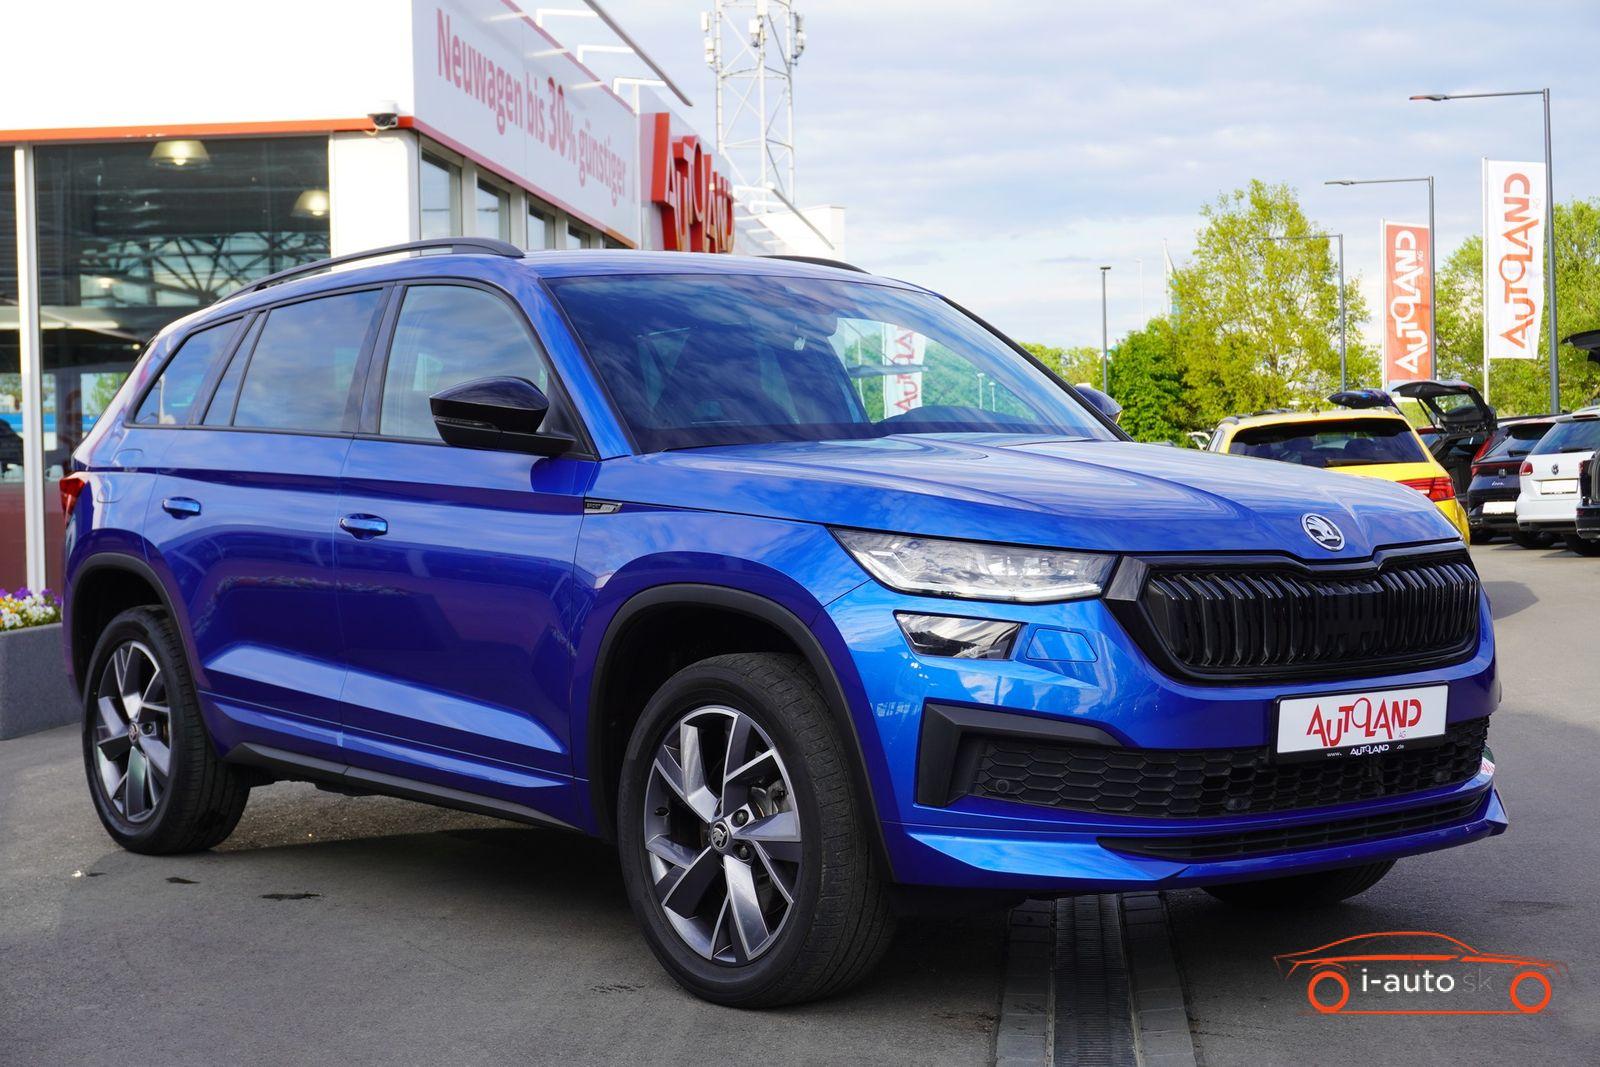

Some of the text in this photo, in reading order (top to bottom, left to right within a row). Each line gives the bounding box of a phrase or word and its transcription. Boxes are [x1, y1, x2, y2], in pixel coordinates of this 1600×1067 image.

[437, 8, 626, 206] Neuwagen bis 30% günstiger
[1391, 231, 1428, 374] AUTOLAND
[1499, 173, 1539, 349] AUTOLAND
[1306, 697, 1422, 747] AUTOLAND
[1350, 744, 1389, 756] AUTOLAND
